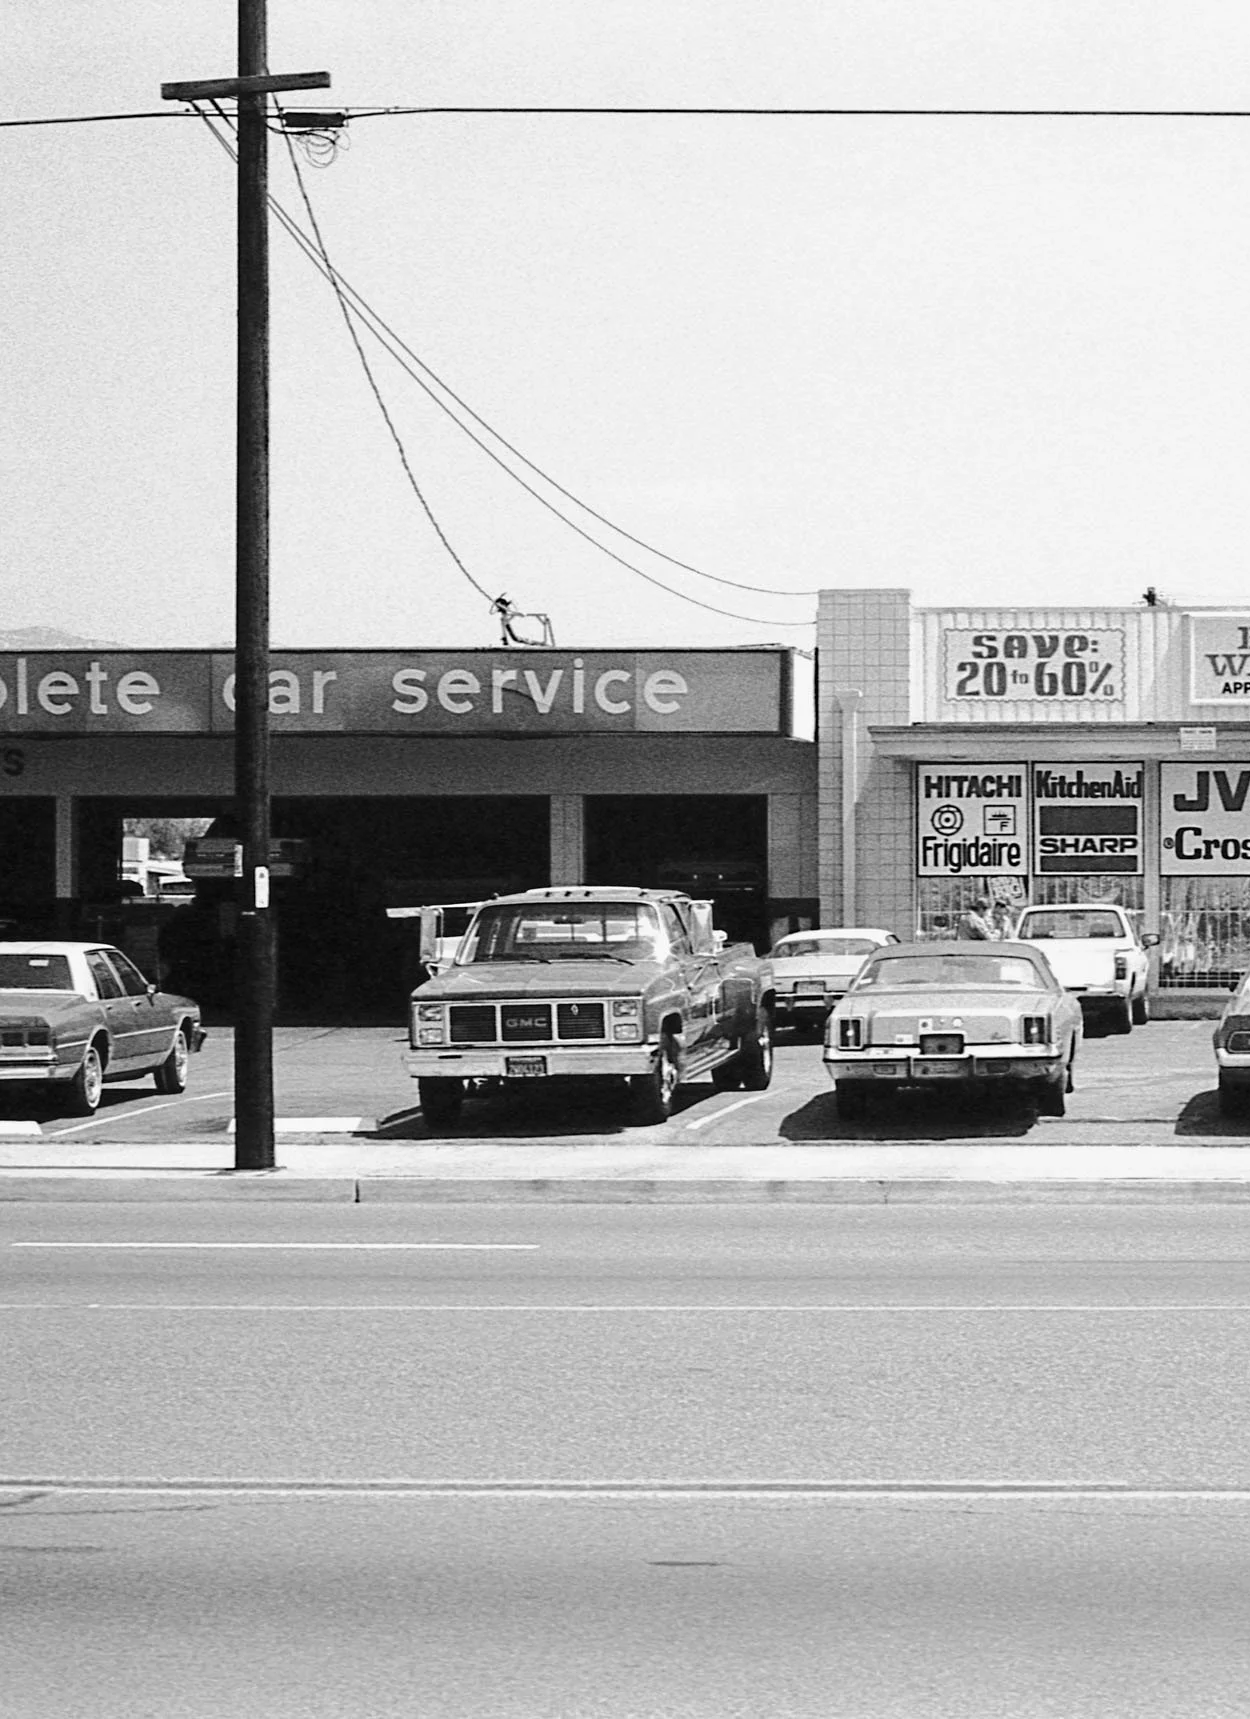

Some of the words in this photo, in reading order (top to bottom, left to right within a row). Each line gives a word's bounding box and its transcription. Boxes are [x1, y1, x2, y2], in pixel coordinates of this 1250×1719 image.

[391, 657, 689, 714] service
[956, 661, 1007, 697] 20
[1010, 669, 1029, 684] to
[1034, 661, 1114, 697] 60%
[924, 775, 1022, 799] HITACHI
[1035, 770, 1144, 799] KitchenAid
[922, 836, 1021, 873] Frigidaire
[1039, 837, 1138, 854] SHARP
[505, 1017, 548, 1028] GMC
